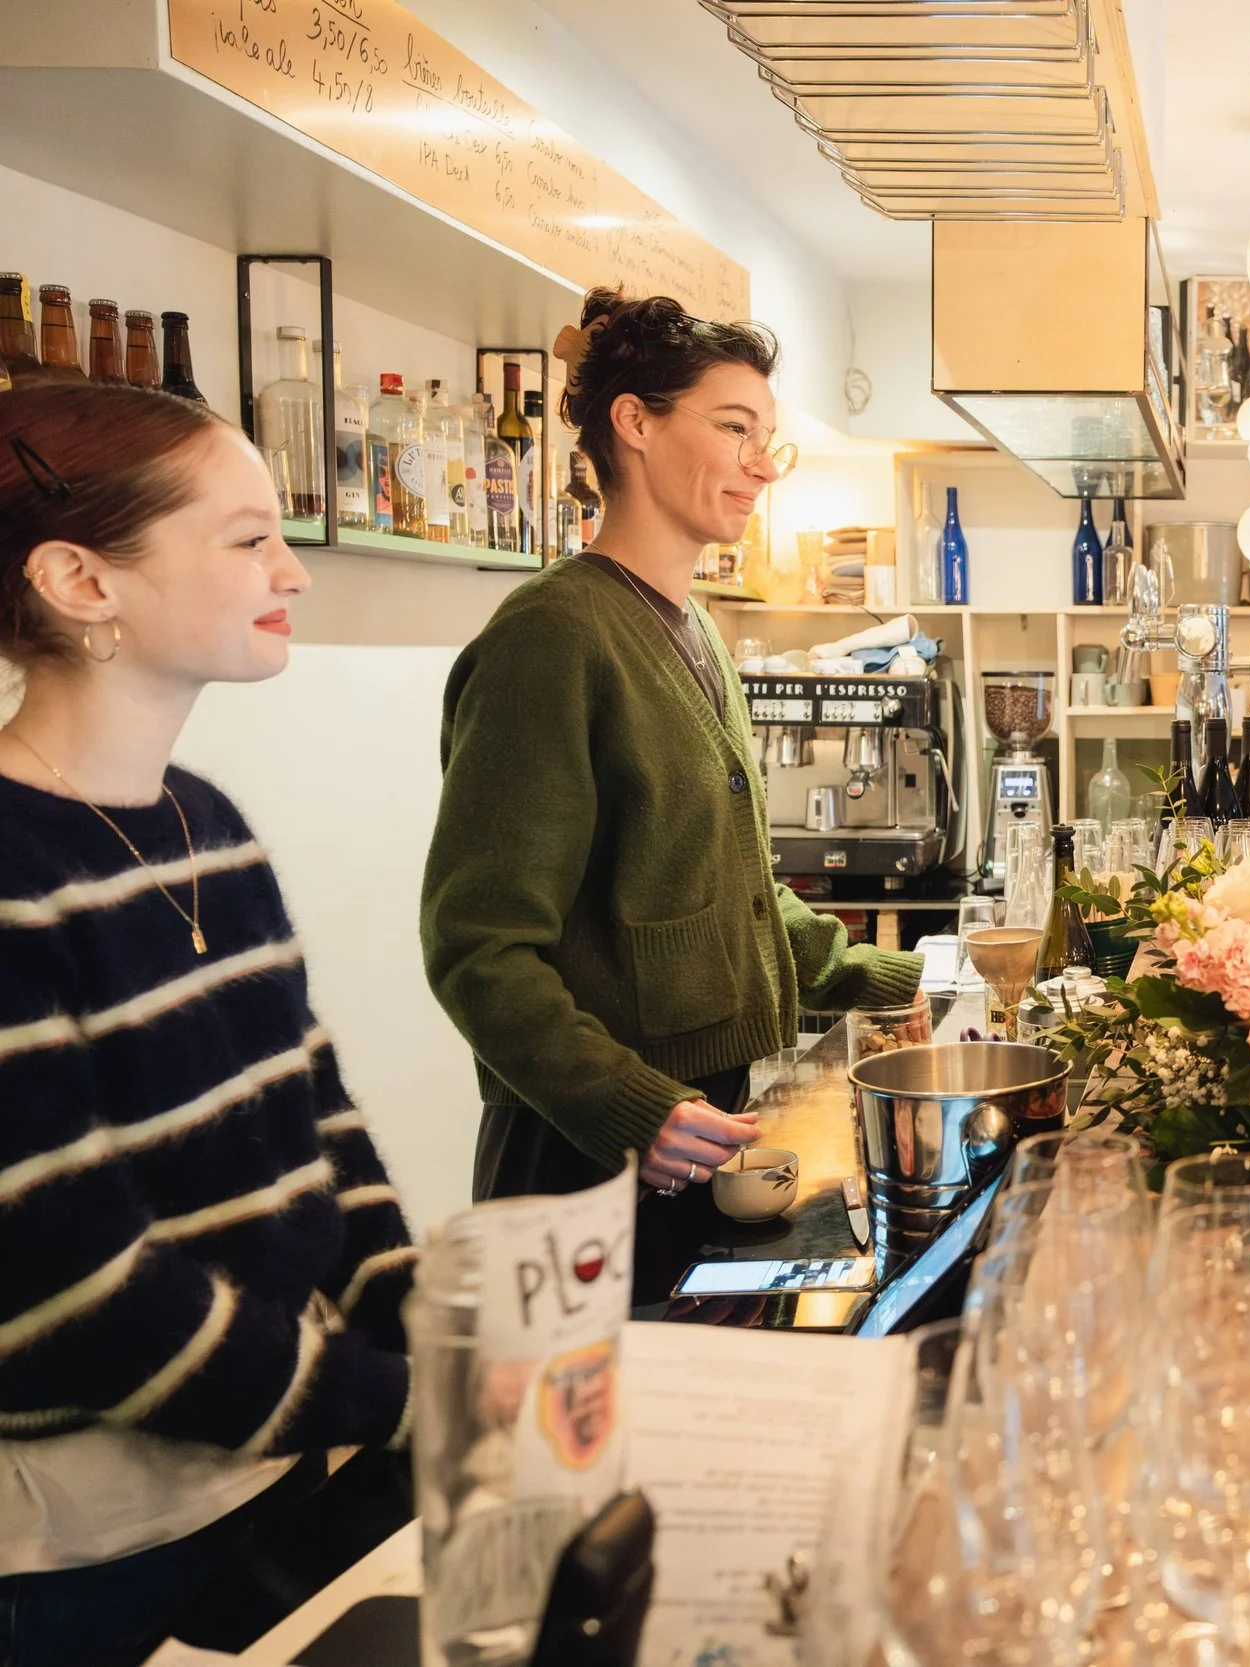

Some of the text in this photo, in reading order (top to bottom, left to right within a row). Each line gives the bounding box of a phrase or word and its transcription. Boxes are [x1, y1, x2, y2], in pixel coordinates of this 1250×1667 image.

[419, 141, 439, 172] IPA
[483, 478, 514, 495] PASTI
[775, 683, 804, 695] PER
[816, 684, 907, 697] L'ESPRESSO
